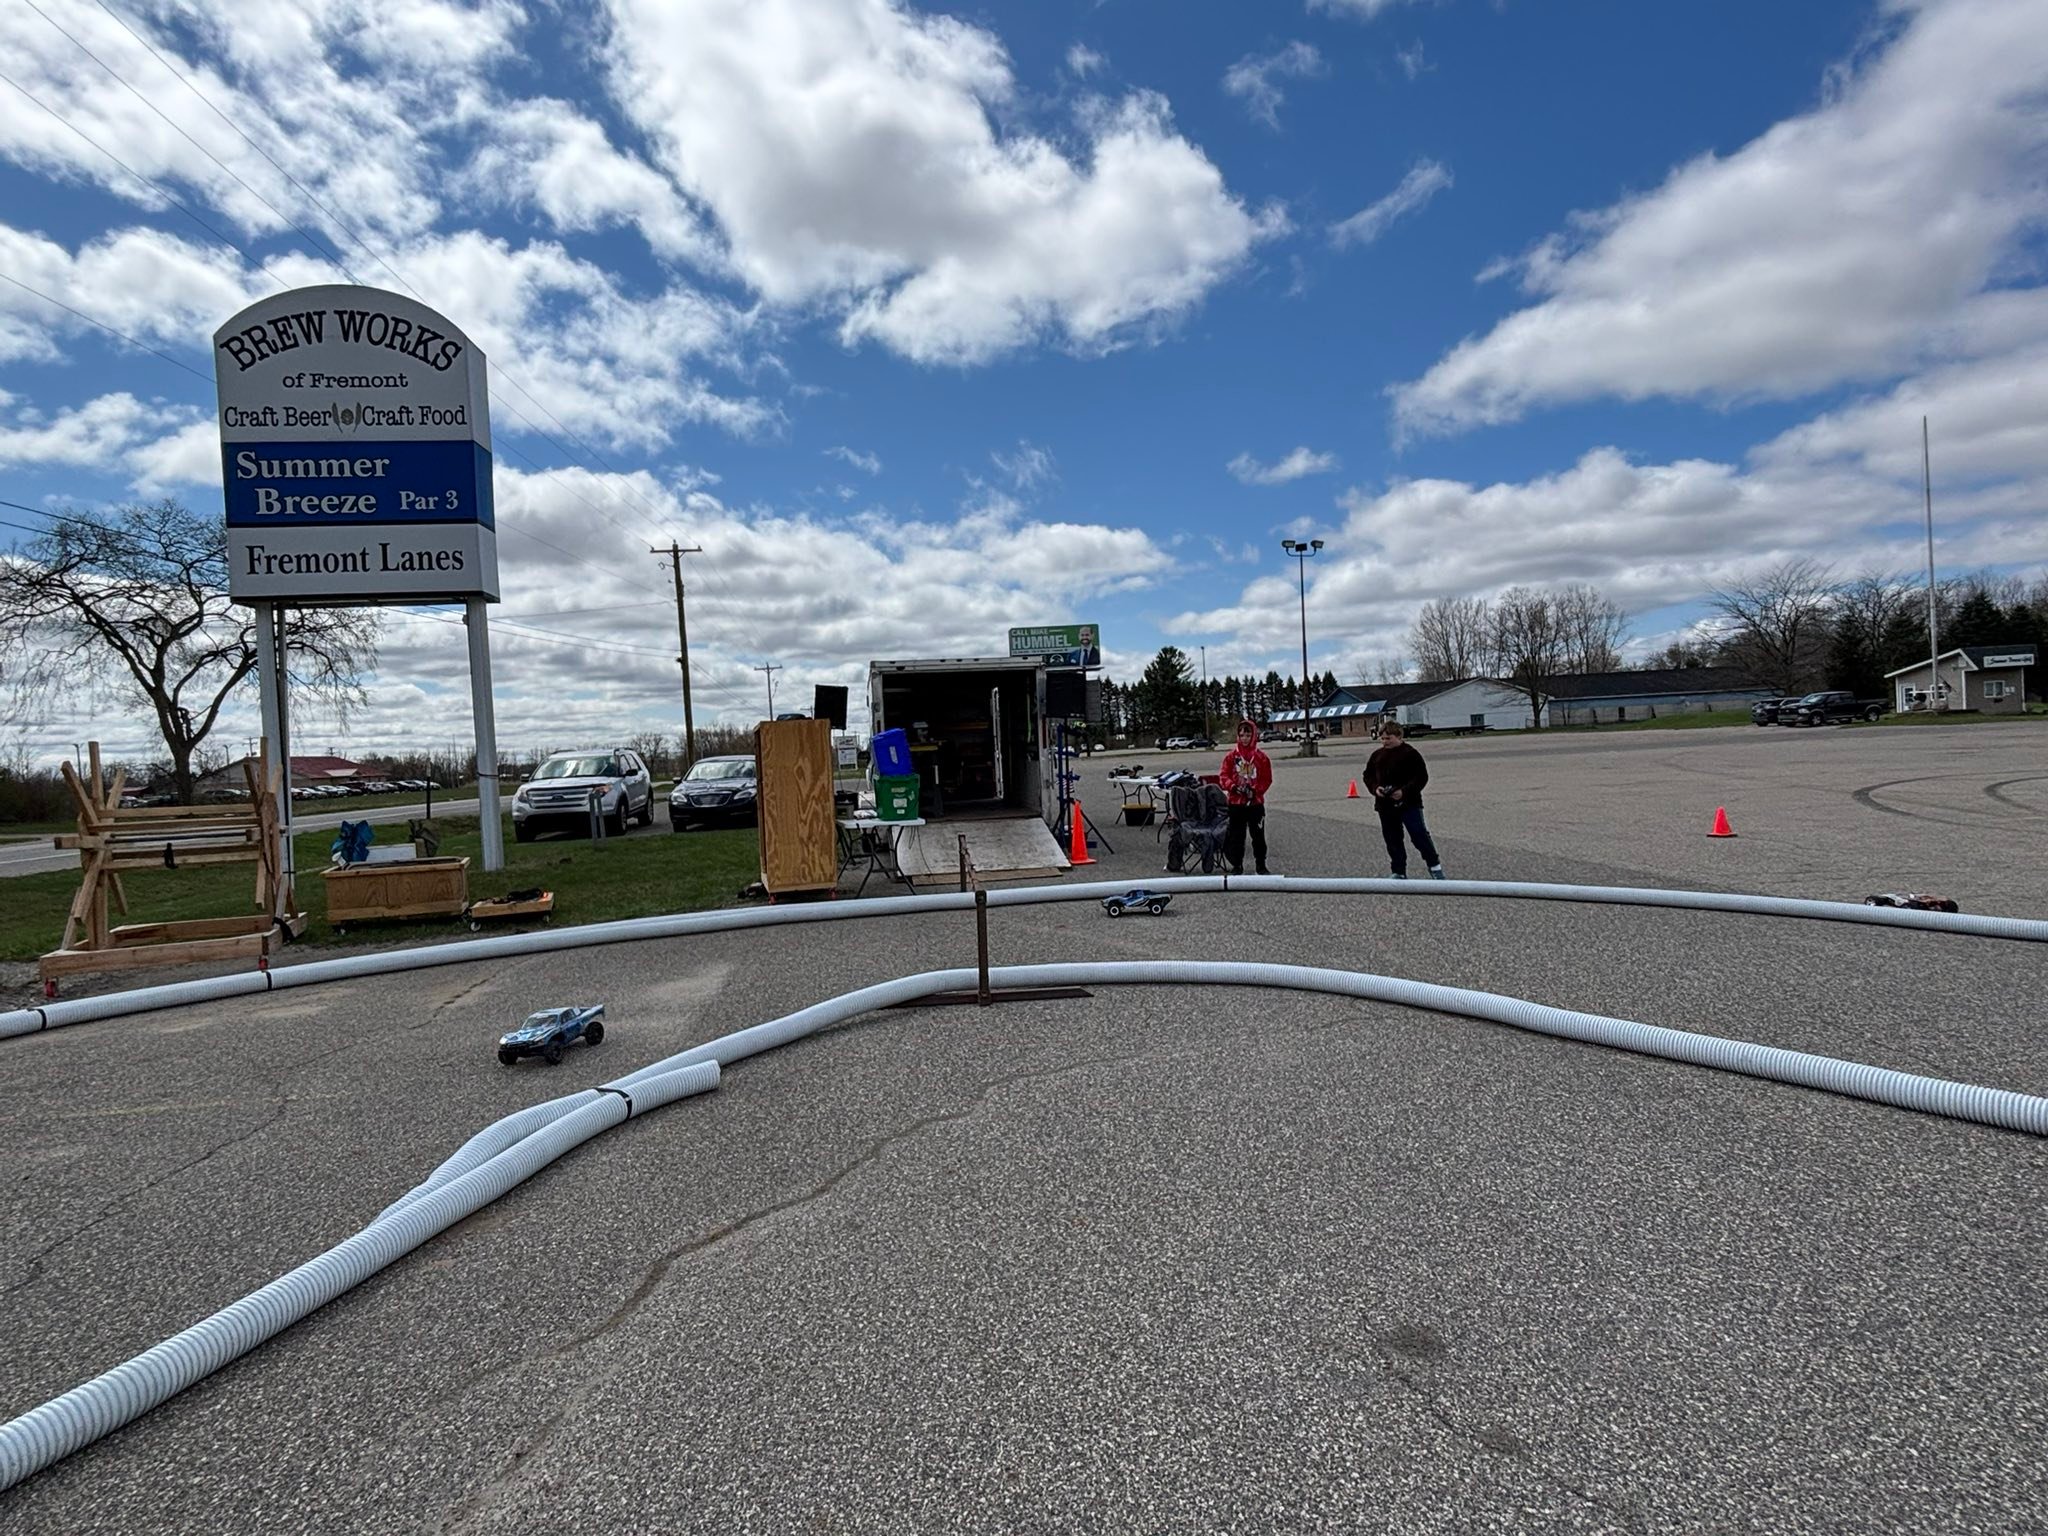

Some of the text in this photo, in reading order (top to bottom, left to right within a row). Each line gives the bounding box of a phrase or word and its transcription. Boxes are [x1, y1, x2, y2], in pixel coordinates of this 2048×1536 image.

[220, 309, 463, 372] BREW WORKS
[282, 372, 408, 388] of Fremont
[224, 405, 467, 427] Craft Beer Craft Food
[236, 451, 390, 479] Summer
[254, 488, 459, 515] Breeze Par 3
[245, 542, 464, 575] Fremont Lanes
[1011, 634, 1072, 649] HUMMEL
